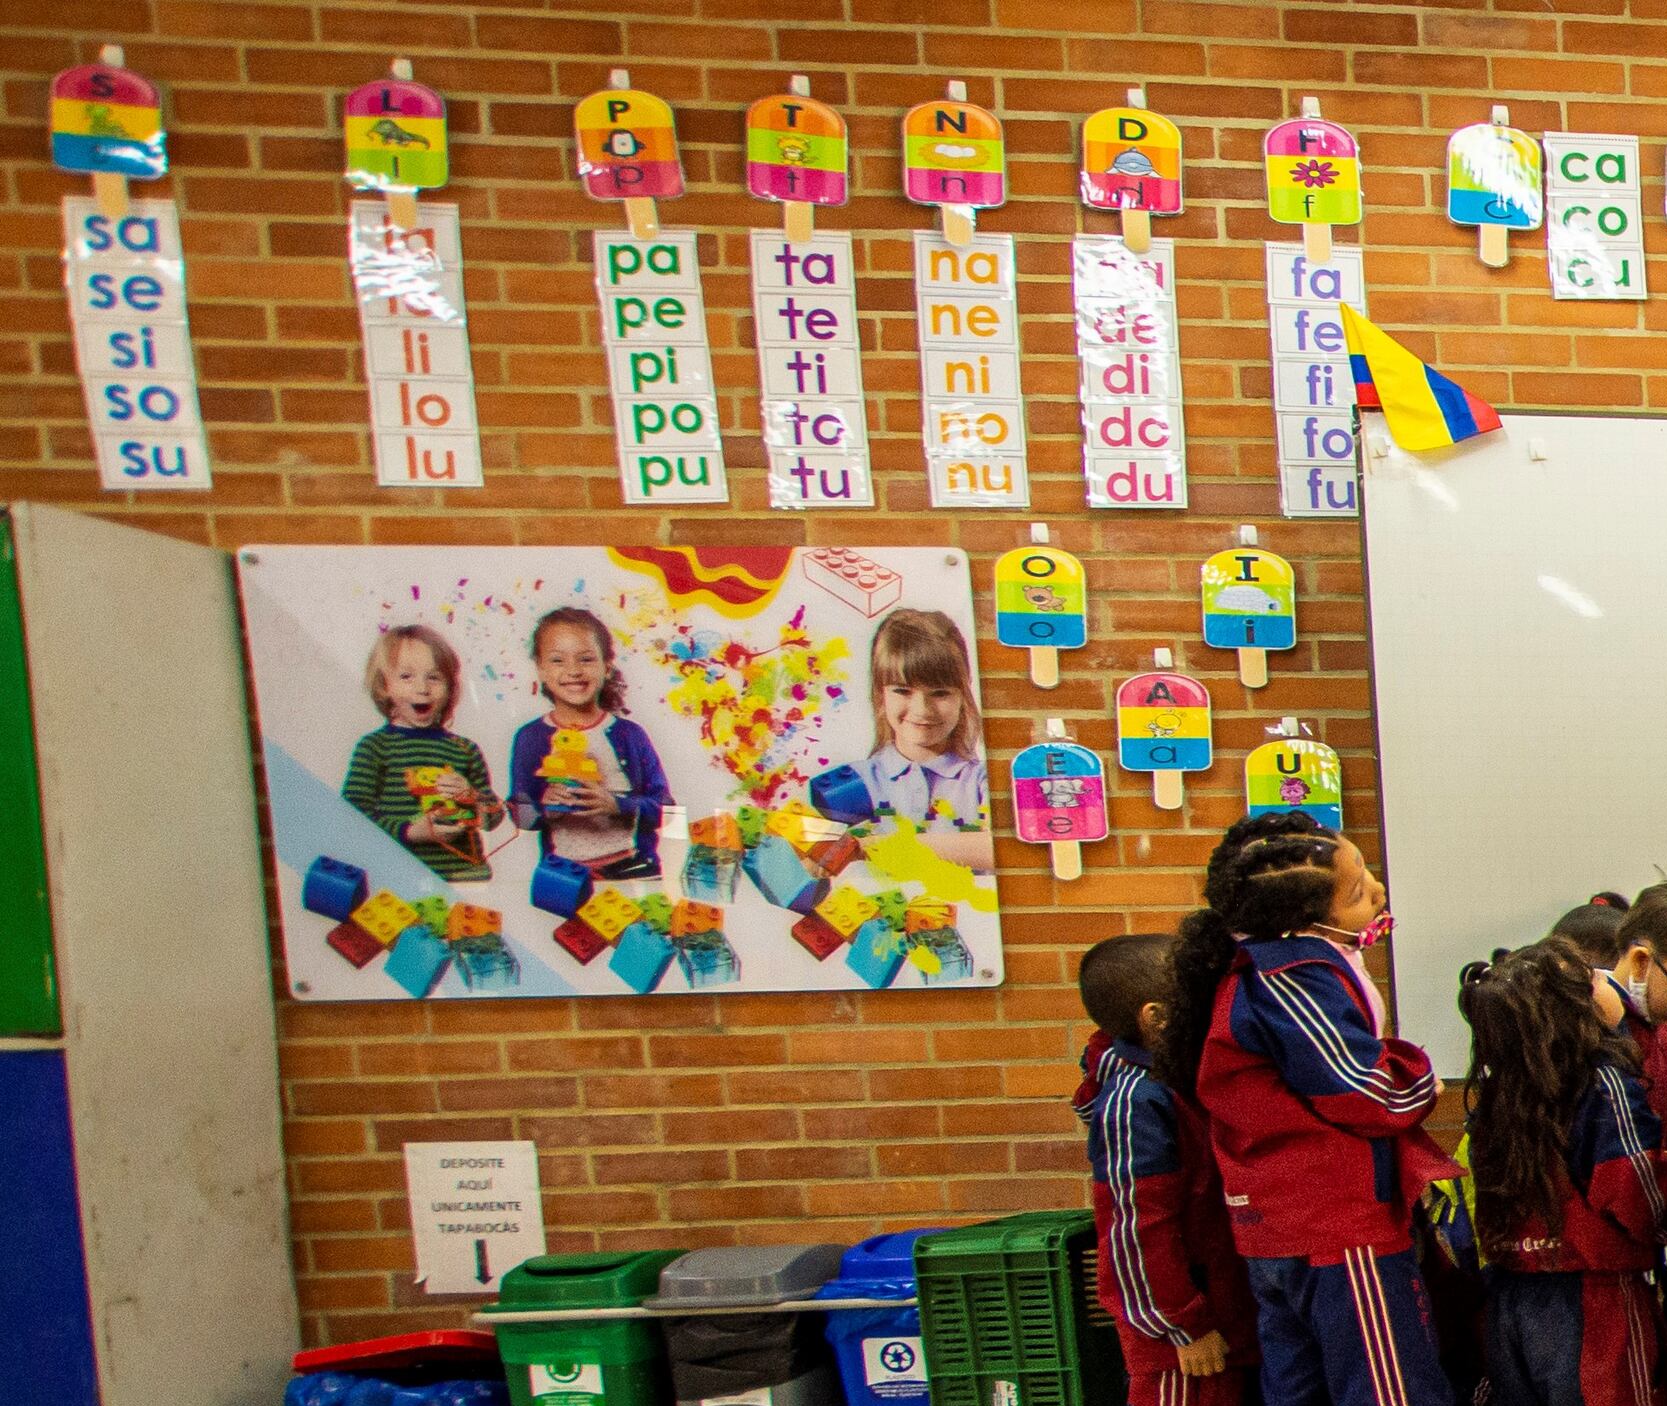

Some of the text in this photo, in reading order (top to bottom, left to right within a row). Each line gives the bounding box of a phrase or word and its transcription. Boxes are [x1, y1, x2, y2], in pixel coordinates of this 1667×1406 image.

[91, 75, 115, 97] S
[382, 90, 401, 113] L
[609, 100, 628, 123] P
[782, 105, 799, 127] T
[938, 110, 966, 134] N
[1120, 117, 1147, 141] D
[1560, 152, 1626, 183] ca
[83, 215, 159, 255] sa
[608, 245, 680, 285] pa
[775, 244, 835, 286] ta
[930, 239, 998, 284] na
[1291, 256, 1341, 299] fa
[89, 274, 163, 312] se
[615, 297, 686, 338] pe
[779, 297, 838, 340] te
[931, 304, 999, 337] ne
[109, 326, 156, 369] si
[630, 346, 678, 393] pi
[787, 351, 827, 394] ti
[945, 356, 990, 393] ni
[1103, 353, 1149, 394] di
[1306, 365, 1333, 405] fi
[105, 384, 180, 422] so
[400, 380, 451, 427] lo
[632, 403, 703, 444] po
[1304, 417, 1353, 459] fo
[120, 442, 188, 478] su
[406, 435, 455, 479] lu
[638, 456, 710, 496] pu
[1106, 462, 1173, 502] du
[1022, 556, 1055, 578] O
[1146, 683, 1177, 703] A
[1278, 754, 1300, 775] U
[441, 1159, 504, 1168] DEPOSITE
